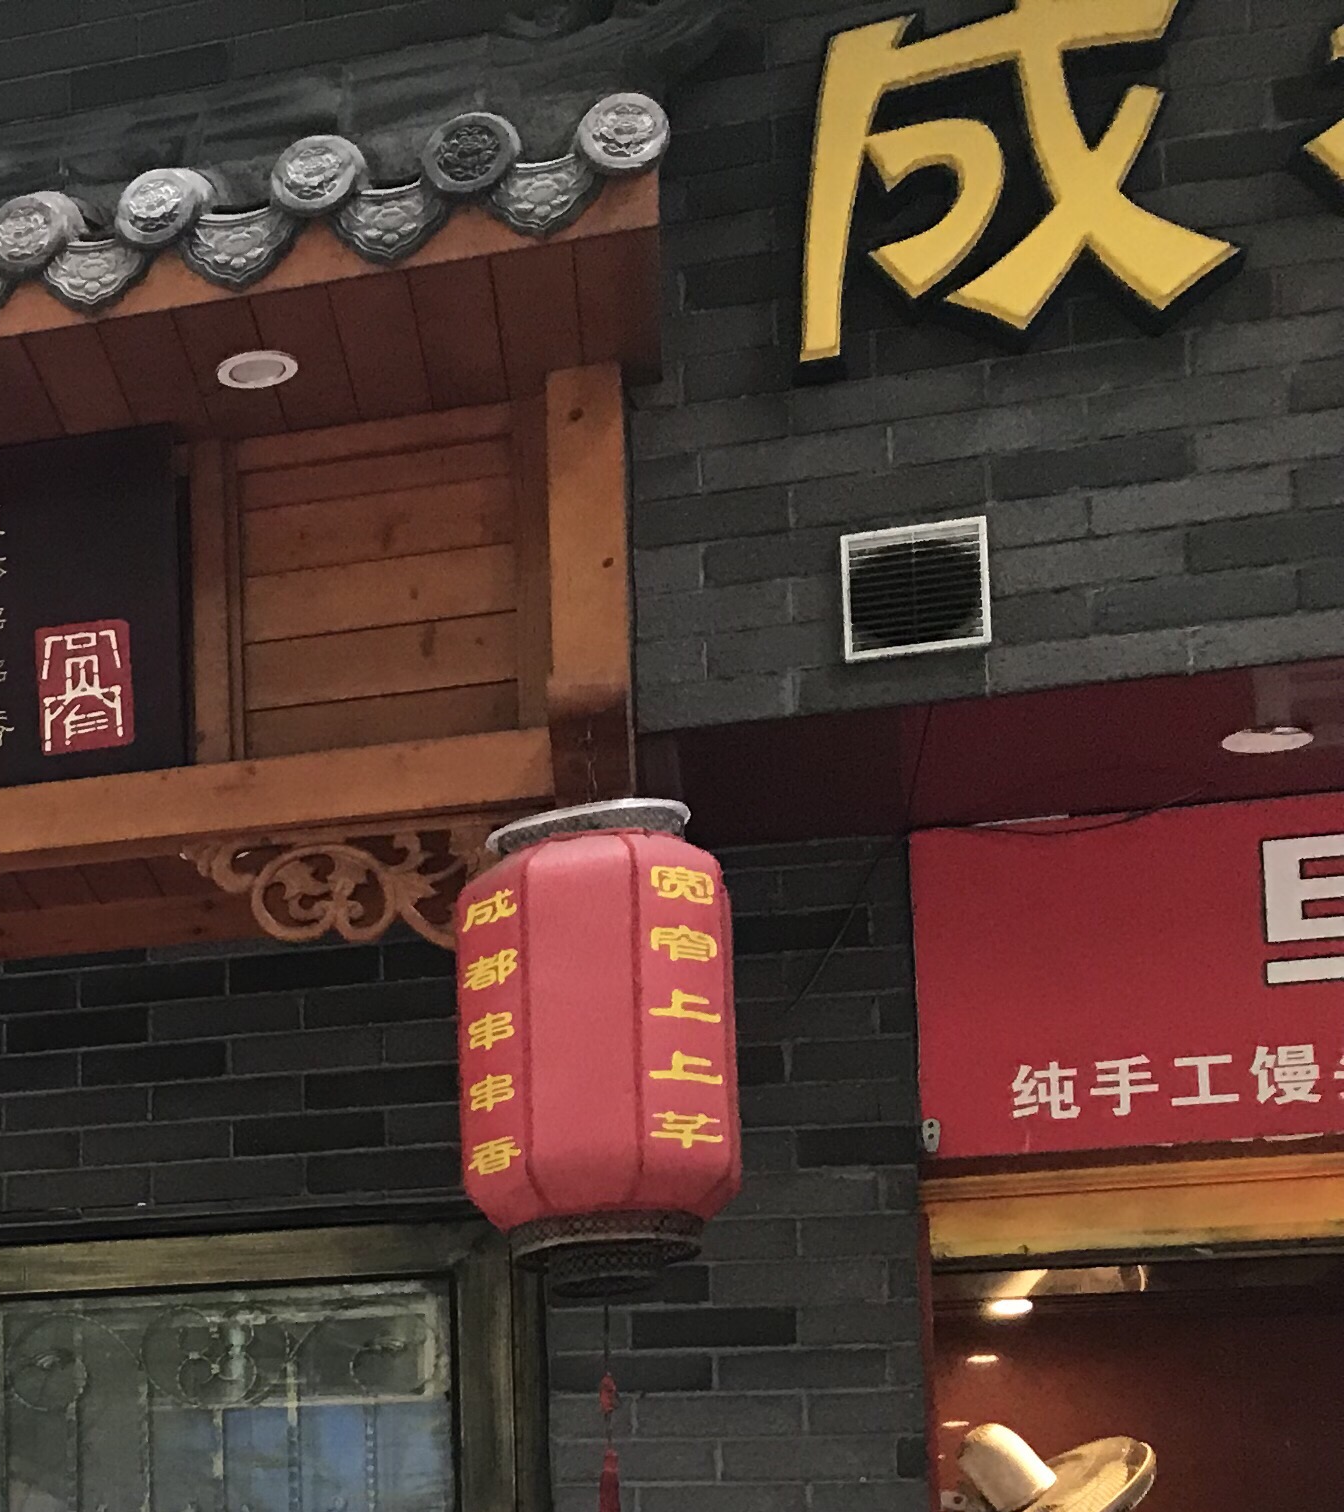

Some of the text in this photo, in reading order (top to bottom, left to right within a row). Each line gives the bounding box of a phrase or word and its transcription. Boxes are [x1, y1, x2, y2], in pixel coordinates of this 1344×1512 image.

[799, 0, 1344, 362] 成
[462, 889, 521, 1176] 成都串串香
[1012, 1045, 1344, 1121] 纯手工馒
